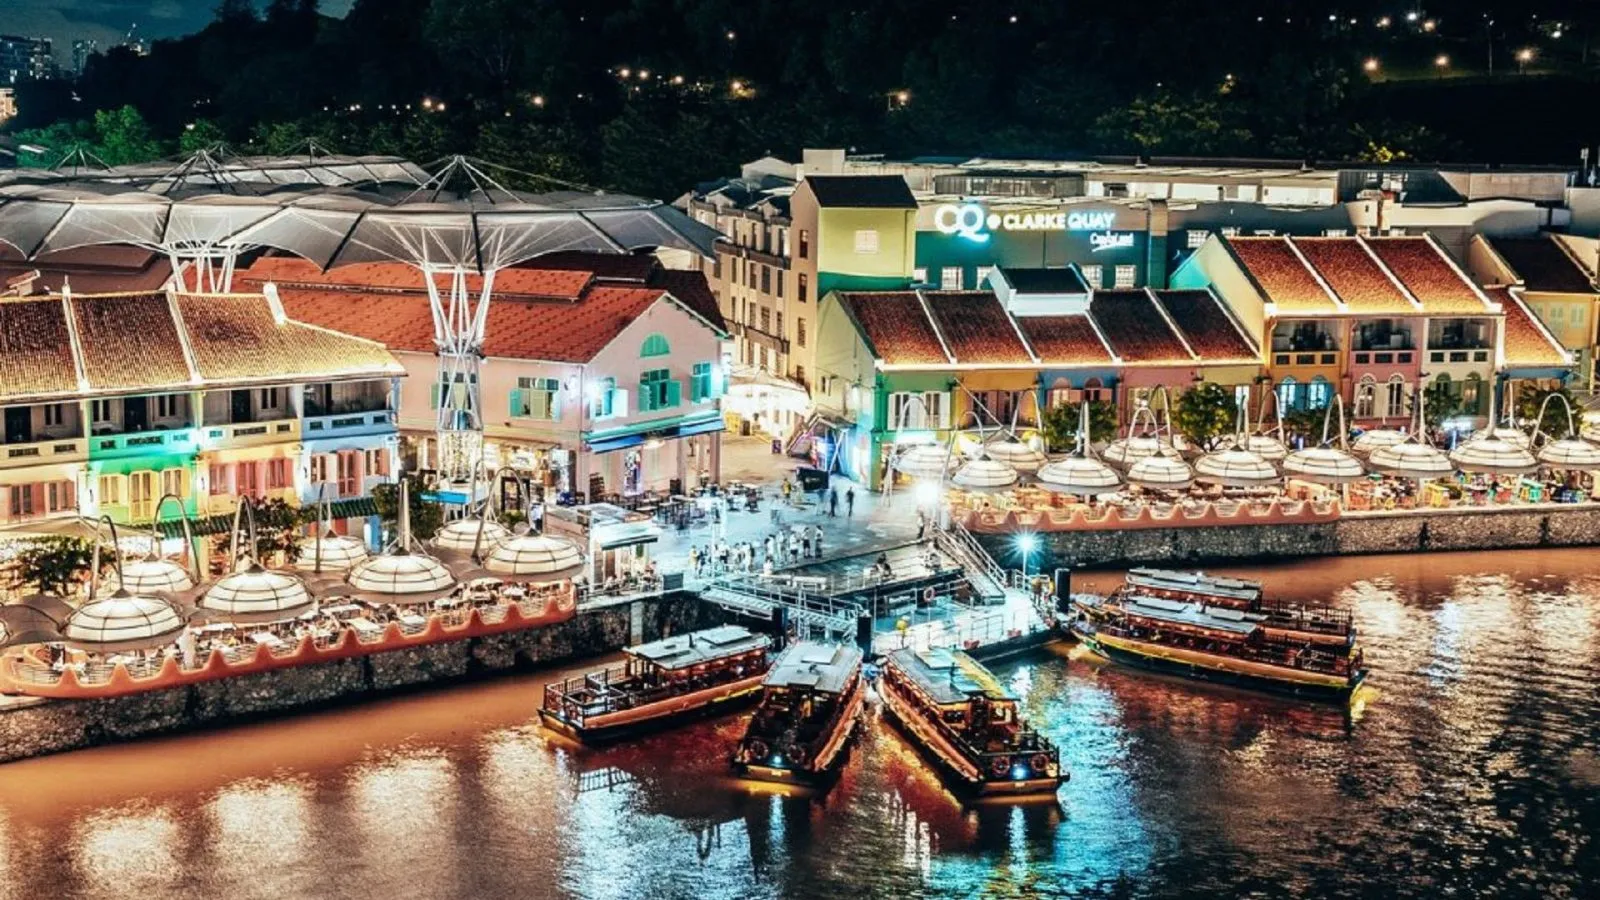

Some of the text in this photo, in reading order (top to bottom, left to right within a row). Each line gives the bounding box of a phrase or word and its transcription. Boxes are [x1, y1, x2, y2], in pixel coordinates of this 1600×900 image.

[934, 204, 989, 242] CQ
[1003, 213, 1066, 230] CLARKE
[1067, 212, 1116, 230] QUAY
